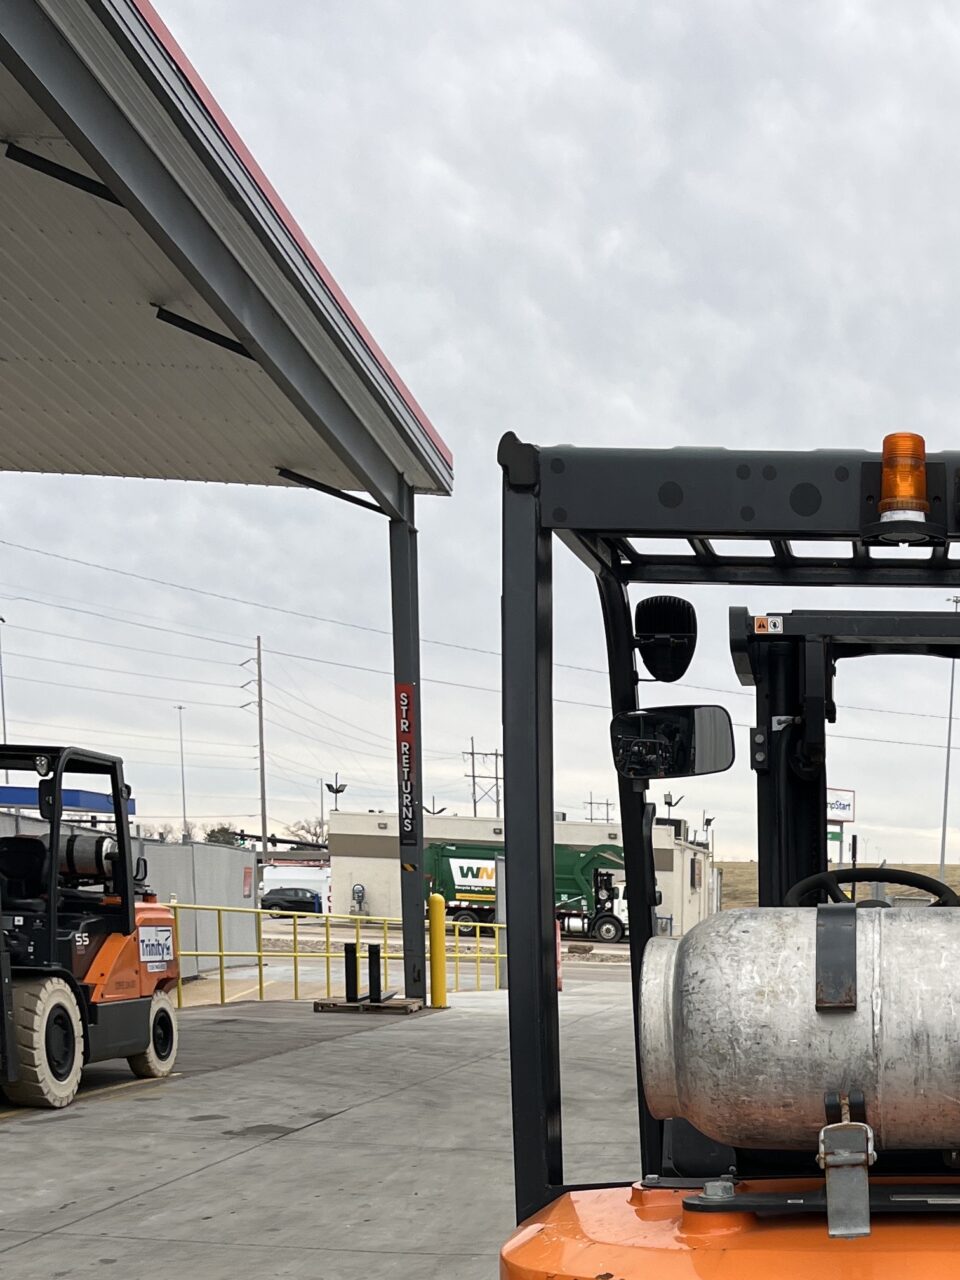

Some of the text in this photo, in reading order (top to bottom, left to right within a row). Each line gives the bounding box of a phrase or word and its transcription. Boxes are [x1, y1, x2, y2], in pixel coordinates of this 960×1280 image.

[400, 692, 413, 831] STR RETURNS
[140, 938, 165, 961] Trinity
